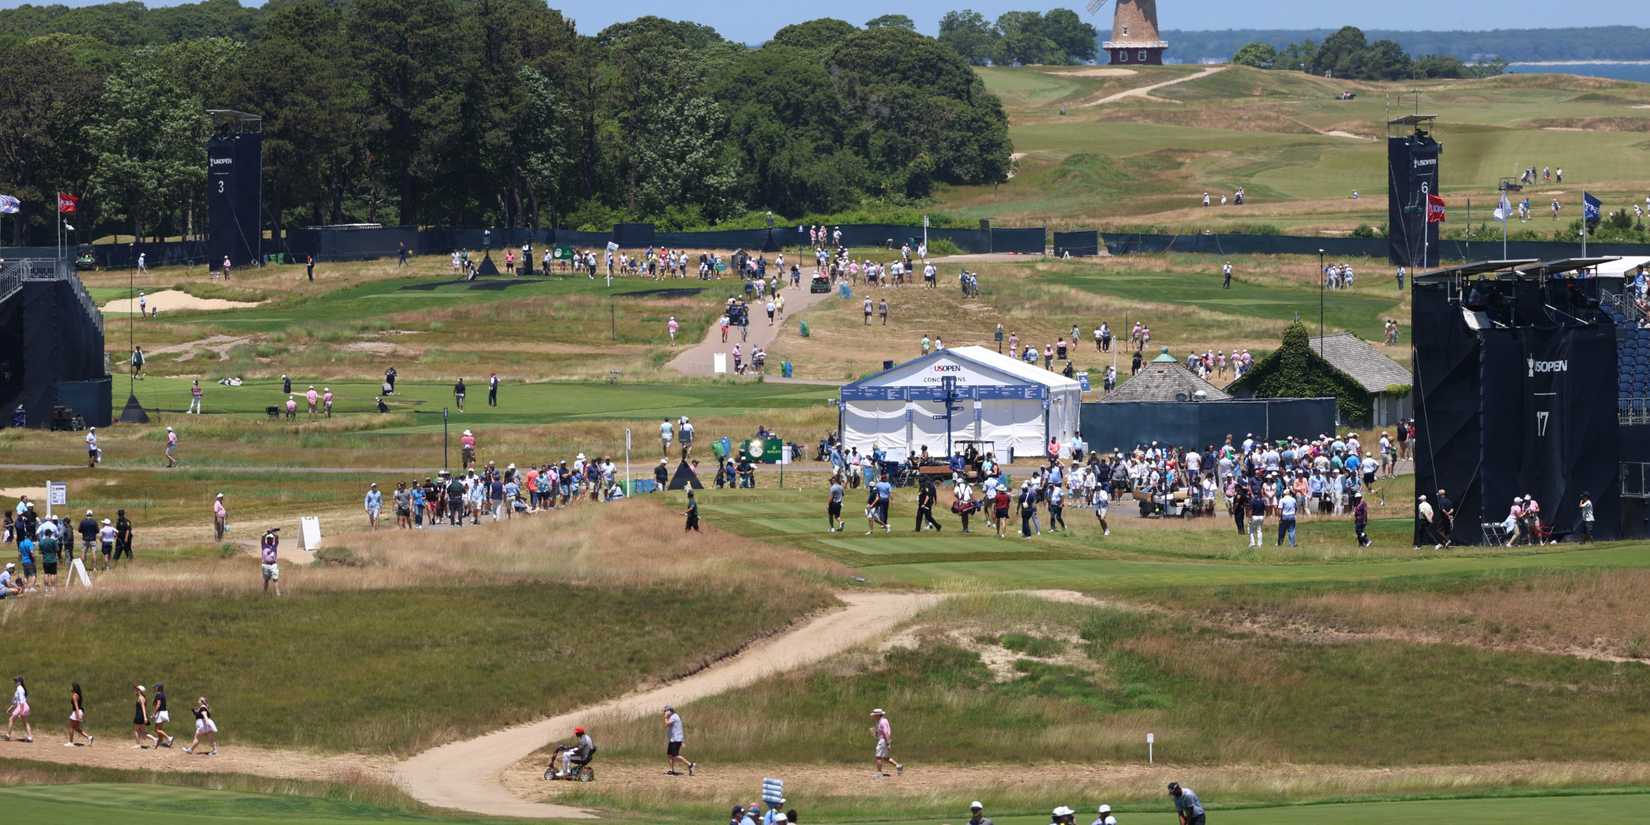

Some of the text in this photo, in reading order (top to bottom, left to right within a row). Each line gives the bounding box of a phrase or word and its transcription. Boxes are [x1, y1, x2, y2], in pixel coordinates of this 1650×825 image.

[218, 180, 224, 193] 3
[1421, 181, 1429, 194] 6
[1536, 411, 1550, 437] 17
